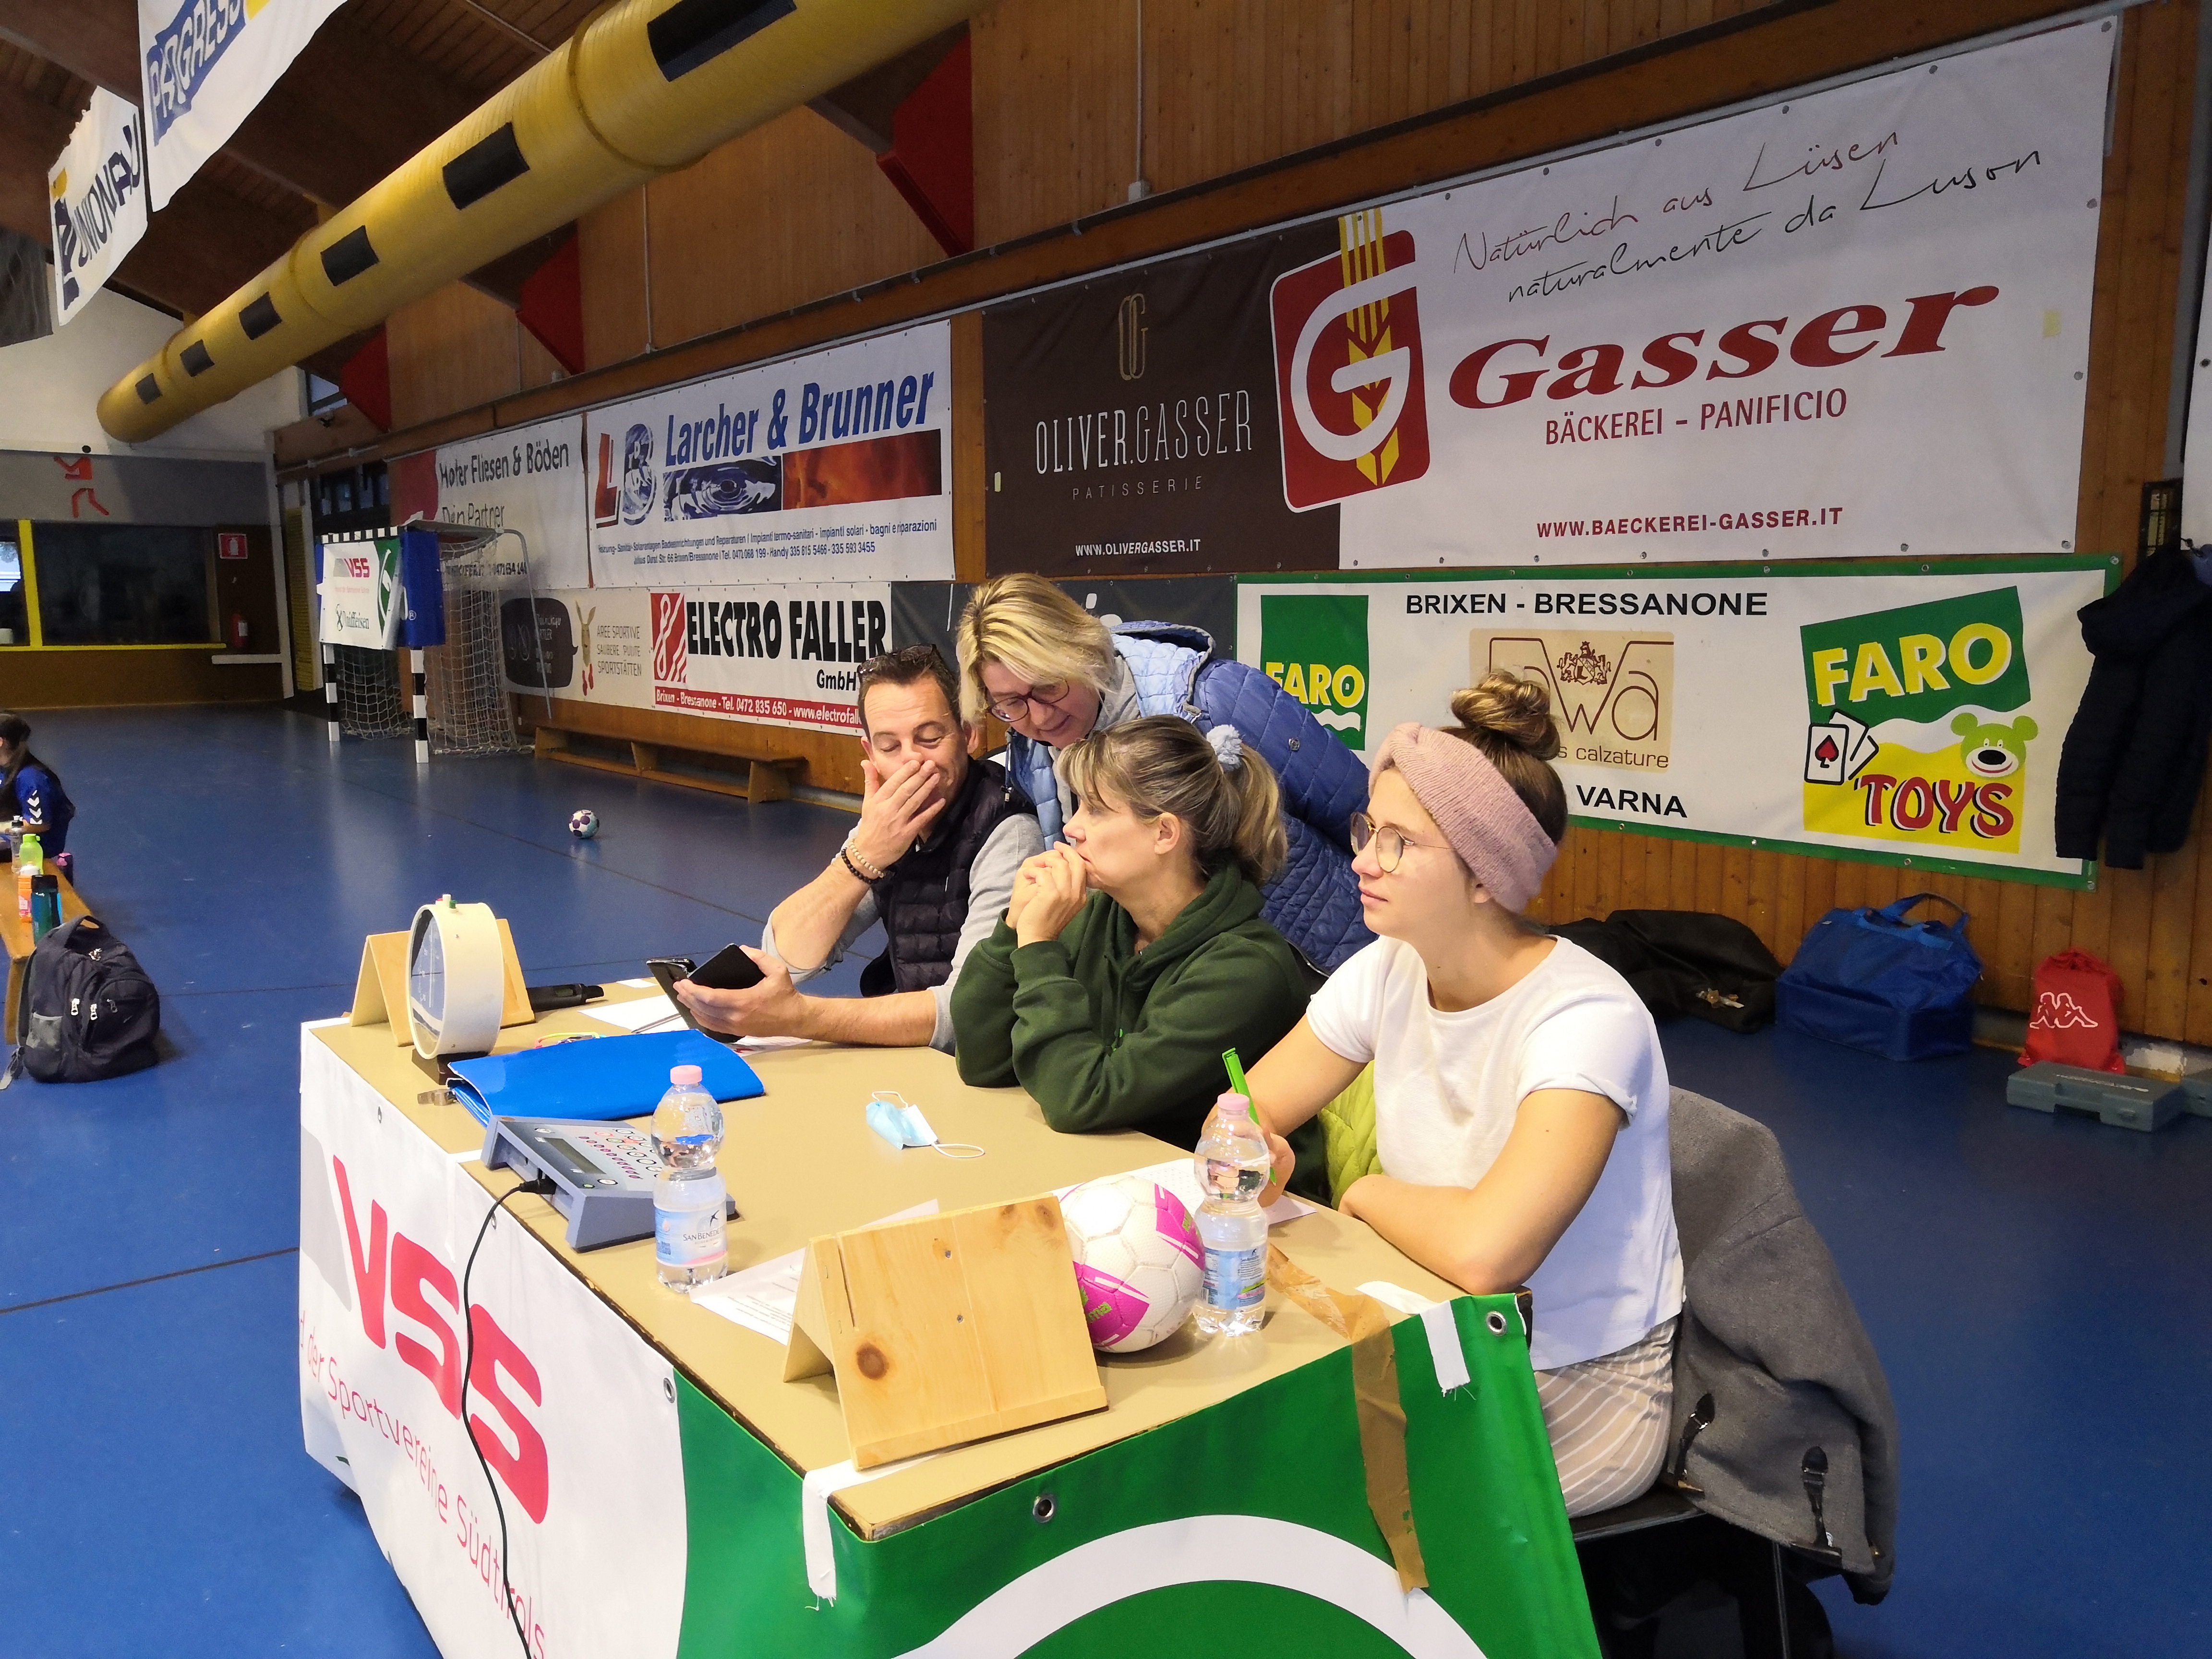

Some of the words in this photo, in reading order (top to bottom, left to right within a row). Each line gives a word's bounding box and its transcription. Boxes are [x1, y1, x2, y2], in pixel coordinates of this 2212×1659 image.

[1453, 196, 1639, 274] Natürlich
[1663, 188, 1713, 214] aus
[1743, 130, 1898, 192] Lüsen
[1508, 211, 1772, 302] naturalmente
[1785, 196, 1837, 234] da
[1860, 151, 2041, 210] Luson
[1449, 285, 1999, 409] Gasser
[666, 404, 759, 466] Larcher
[768, 388, 788, 448] &
[798, 371, 934, 444] Brunner
[1036, 390, 1251, 474] OLIVER.GASSER
[1546, 408, 1663, 445] BÄCKEREI
[1700, 387, 1847, 432] PANIFICIO
[471, 454, 509, 483] Fliesen
[513, 445, 521, 476] &
[527, 439, 569, 473] Böden
[1072, 476, 1202, 500] PATISSERIE
[468, 503, 505, 528] Partner
[846, 524, 864, 537] solari
[869, 522, 891, 537] bagni
[1537, 507, 1843, 537] WWW.BAECKEREI-GASSER.IT
[722, 550, 732, 559] Tel.
[756, 548, 766, 558] 199
[770, 546, 789, 559] Handy
[790, 546, 800, 556] 335
[831, 543, 844, 553] 335
[846, 542, 856, 553] 593
[858, 541, 875, 553] 3455
[1075, 539, 1201, 556] WWW.OLIVERGASSER.IT
[344, 558, 370, 578] VSS
[1406, 593, 1506, 614] BRIXEN
[1534, 592, 1767, 615] BRESSANONE
[613, 626, 640, 639] SPORTIVE
[686, 600, 781, 659] ELECTRO
[789, 600, 887, 663] FALLER
[817, 669, 857, 692] GmbH
[1813, 623, 2012, 707] FARO
[656, 689, 675, 703] Brixen
[680, 692, 716, 709] Bressanone
[722, 696, 734, 710] Tel.
[736, 698, 753, 713] 0472
[755, 700, 770, 715] 835
[772, 702, 787, 716] 650
[1265, 661, 1366, 709] FARO
[1576, 745, 1669, 768] calzature
[1575, 785, 1687, 818] VARNA
[1854, 773, 2014, 839] TOYS
[333, 1154, 549, 1525] VSS
[308, 1326, 325, 1382] der
[328, 1357, 447, 1524] Sportvereine
